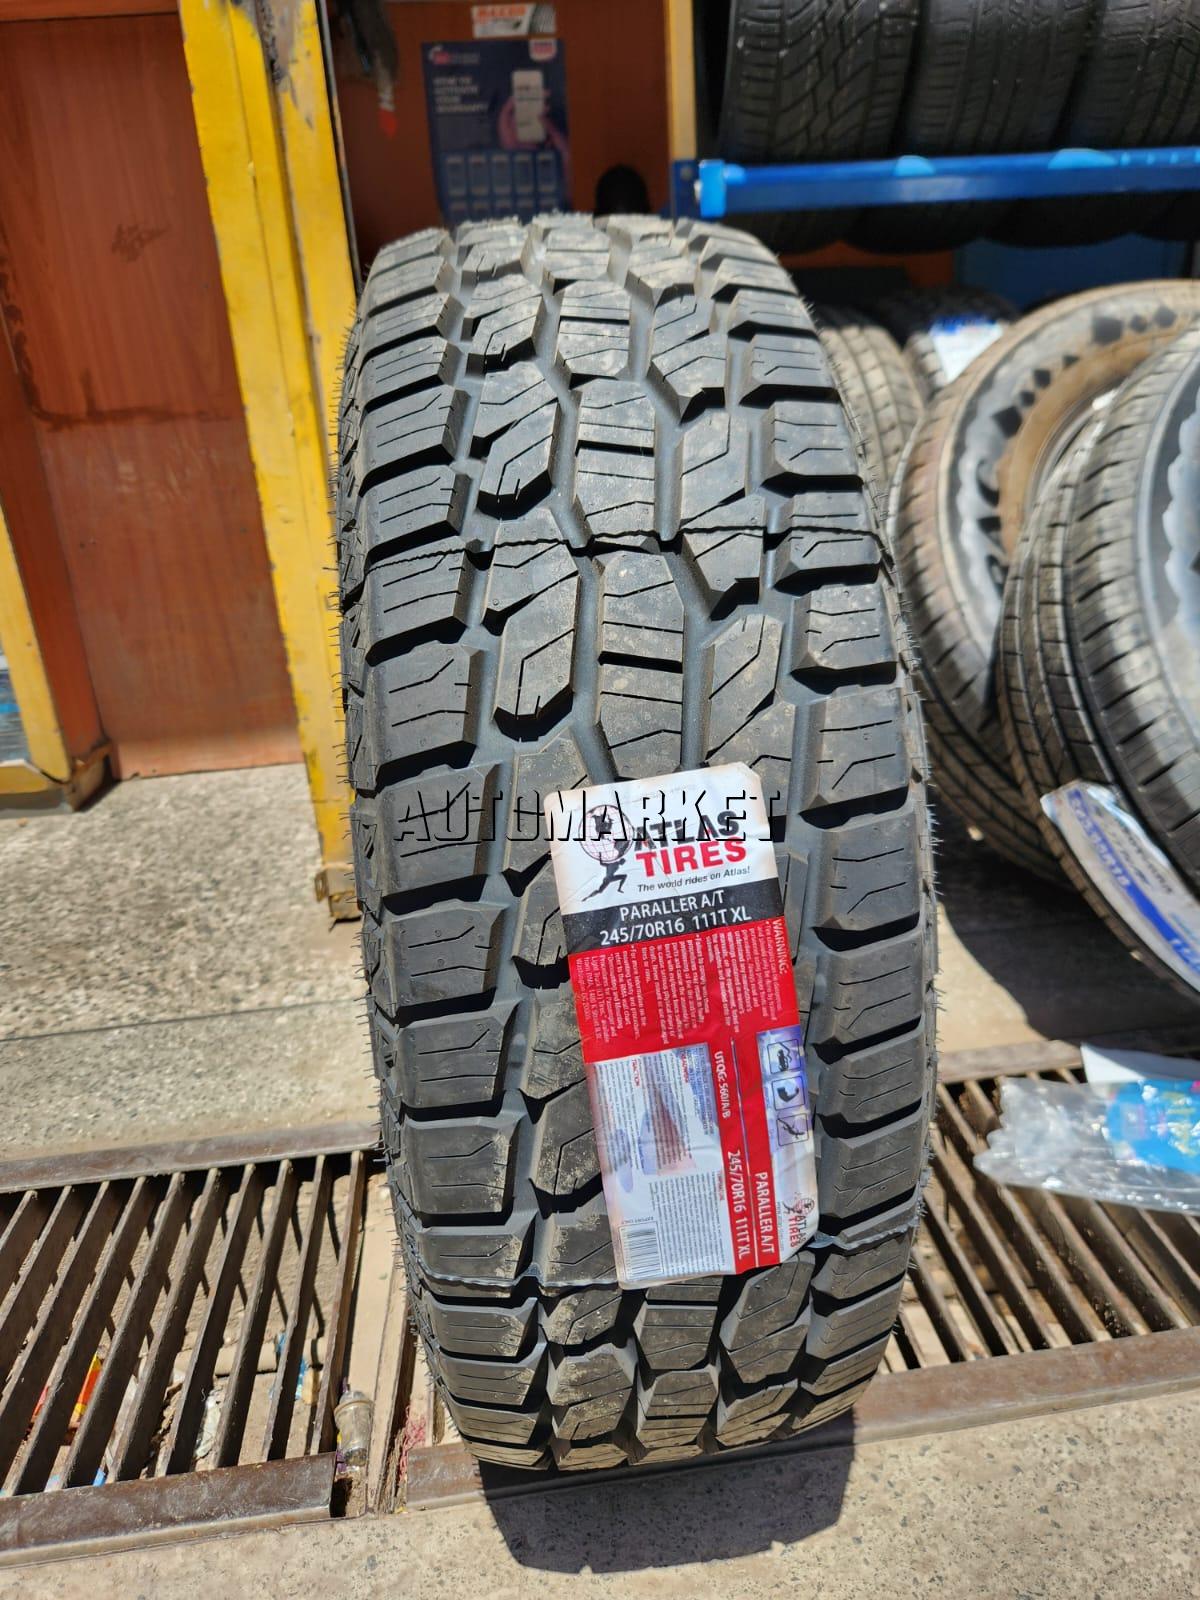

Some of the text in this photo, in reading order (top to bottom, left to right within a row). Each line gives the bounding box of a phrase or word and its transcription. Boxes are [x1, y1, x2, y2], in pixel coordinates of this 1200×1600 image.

[634, 810, 740, 851] ATLAS
[635, 838, 747, 877] TIRES
[637, 883, 655, 893] The
[684, 874, 708, 887] rides
[709, 871, 721, 881] on
[722, 865, 750, 879] Atlas!
[600, 906, 752, 946] 245/70R16 111T XL
[620, 889, 725, 922] PARALLER A/T
[772, 919, 789, 974] WARNING:
[714, 1050, 731, 1119] UTQG: 560/A/B
[727, 1150, 749, 1260] 245/70R16 111T XL
[755, 1172, 775, 1254] PARALLER A/T
